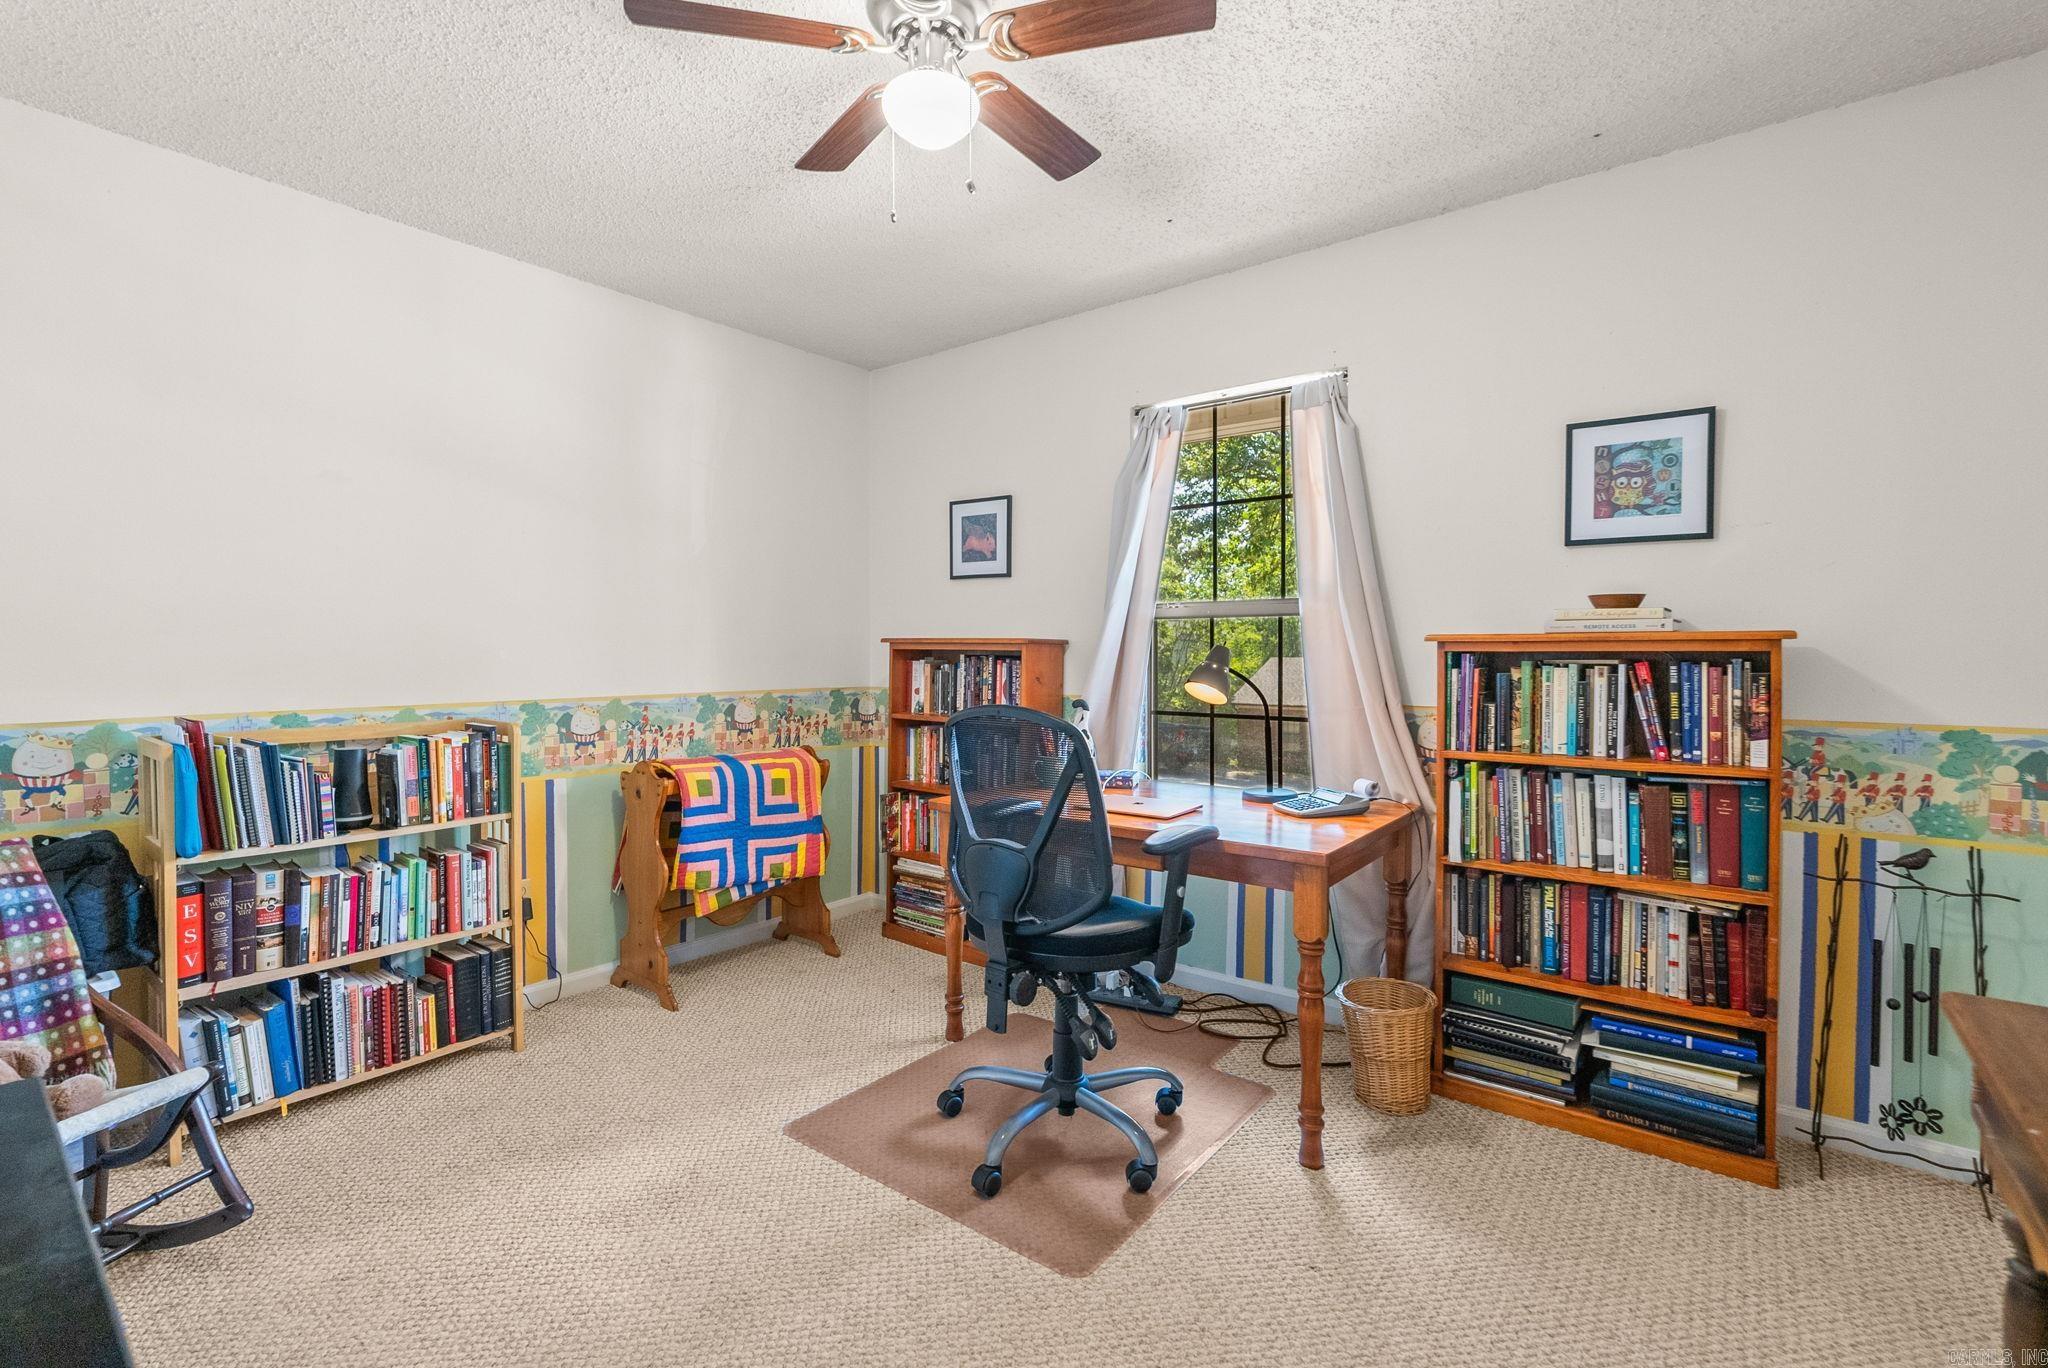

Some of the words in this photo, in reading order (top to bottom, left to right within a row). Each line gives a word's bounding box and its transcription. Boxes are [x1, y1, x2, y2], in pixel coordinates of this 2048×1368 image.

[1670, 666, 1678, 683] MARTIN
[235, 902, 254, 912] NIV
[1545, 886, 1554, 910] PAUL
[334, 984, 343, 1007] BAKING
[237, 1067, 248, 1093] English
